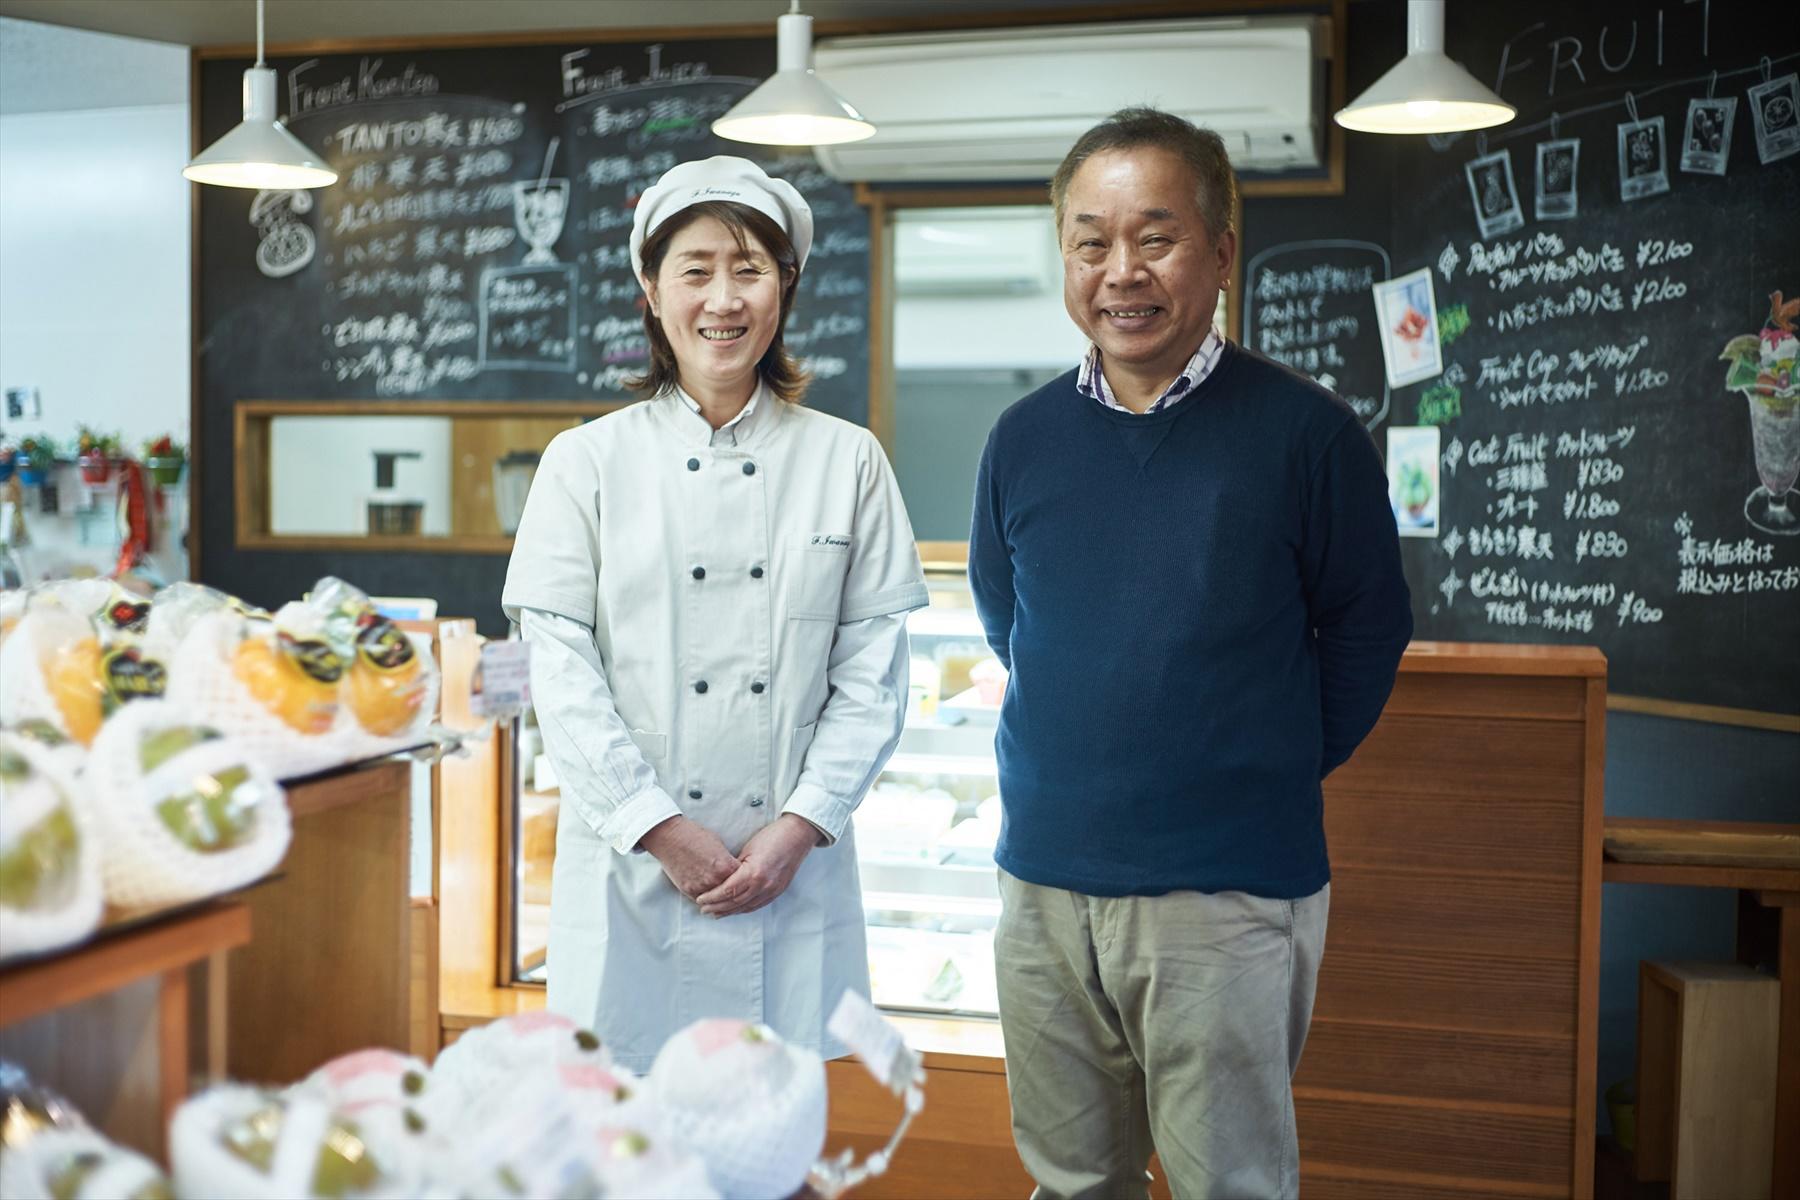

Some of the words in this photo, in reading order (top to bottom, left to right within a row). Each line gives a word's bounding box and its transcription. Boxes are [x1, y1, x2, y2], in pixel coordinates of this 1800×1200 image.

[1493, 0, 1710, 96] FRUIT
[1527, 348, 1559, 386] Cup
[1578, 458, 1624, 491] ¥830
[1576, 530, 1628, 564] ¥830
[1678, 535, 1774, 567] 表示価格は
[1677, 566, 1800, 594] 税込みとなってお
